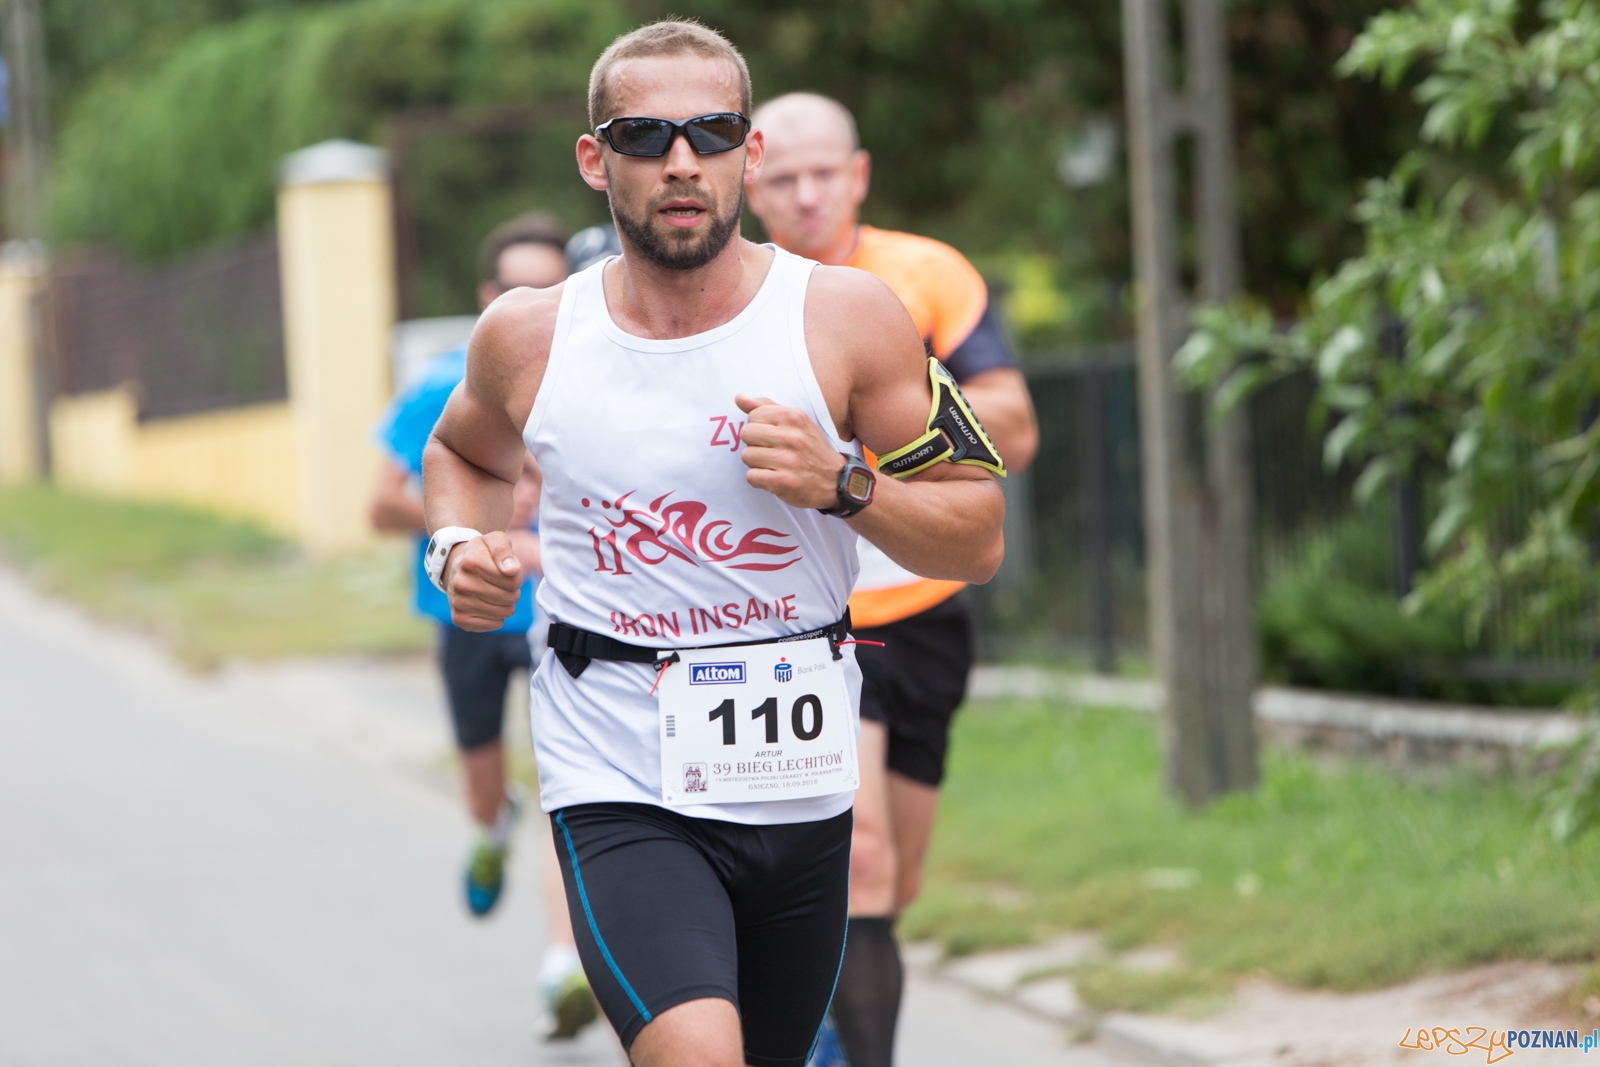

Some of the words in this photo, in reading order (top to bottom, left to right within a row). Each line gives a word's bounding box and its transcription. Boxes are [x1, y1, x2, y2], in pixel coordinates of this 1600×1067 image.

[948, 406, 978, 445] OUTHORN
[892, 445, 934, 469] OUTHORN
[610, 611, 681, 638] IRON
[688, 593, 800, 635] INSANE
[777, 629, 824, 643] compressport
[797, 666, 813, 675] Bank
[814, 662, 827, 672] Polski
[708, 693, 824, 746] 110
[712, 762, 732, 776] 39
[736, 761, 772, 774] BIEG
[777, 750, 844, 773] LECHITÓW
[754, 750, 783, 758] ARTUR
